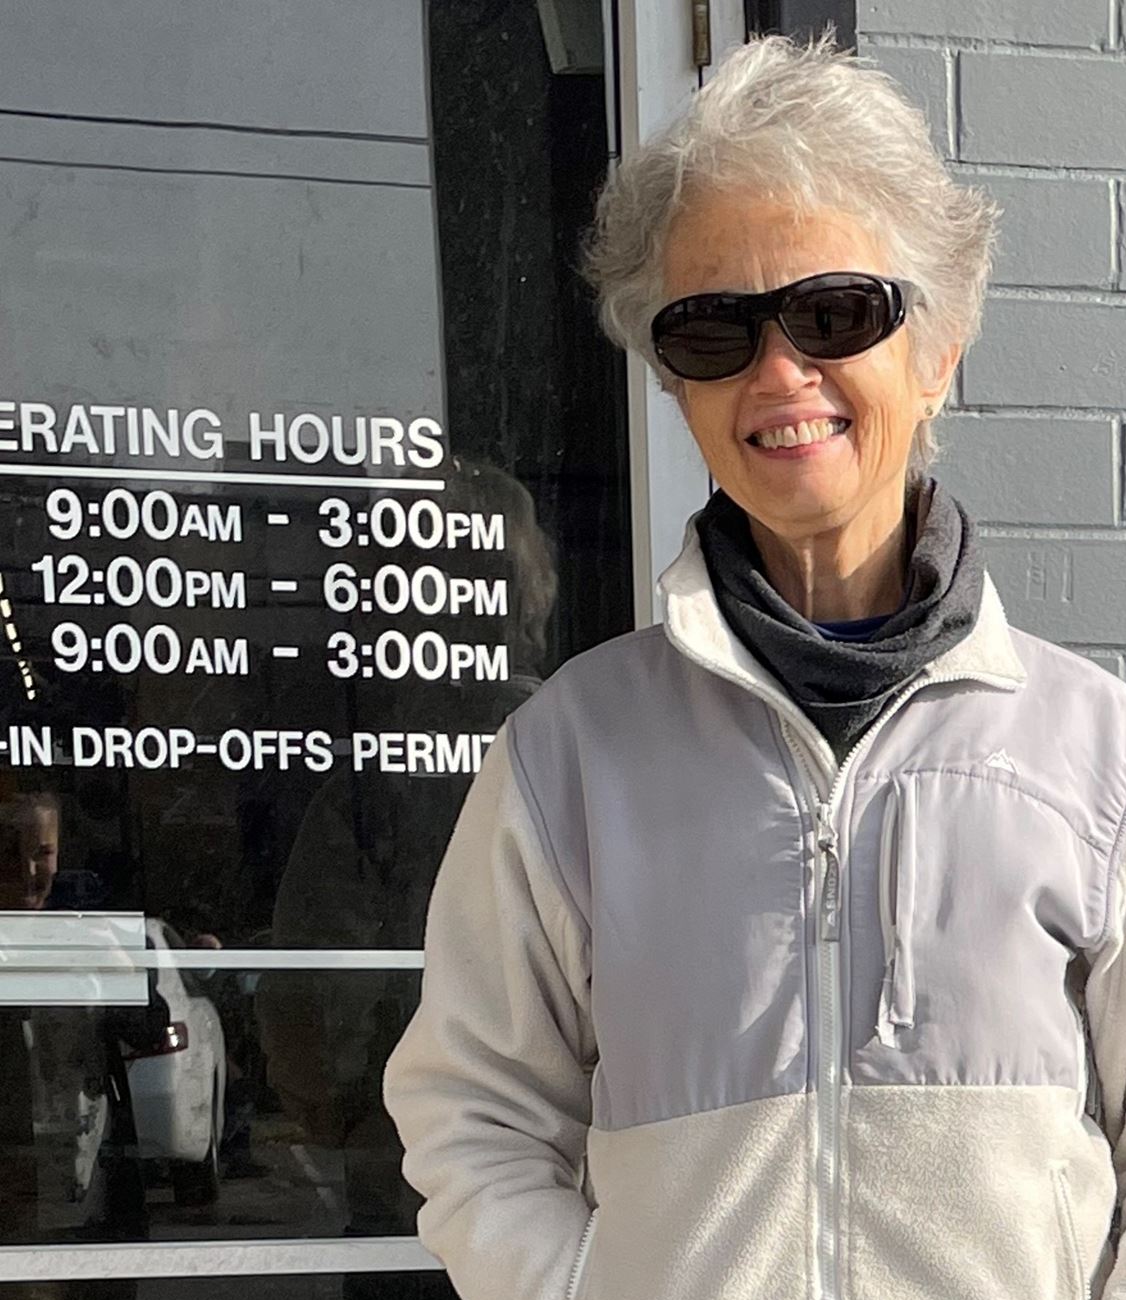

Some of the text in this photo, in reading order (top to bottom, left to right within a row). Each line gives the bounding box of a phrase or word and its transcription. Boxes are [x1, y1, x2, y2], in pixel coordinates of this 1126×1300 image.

[249, 412, 444, 468] HOURS
[46, 488, 242, 542] 9:00AM
[318, 499, 505, 551] 3:00PM
[31, 554, 246, 609] 12:00PM
[323, 564, 508, 616] 6:00PM
[51, 622, 249, 675] 9:00AM
[327, 631, 509, 681] 3:00PM
[72, 727, 333, 772] DROP-OFFS
